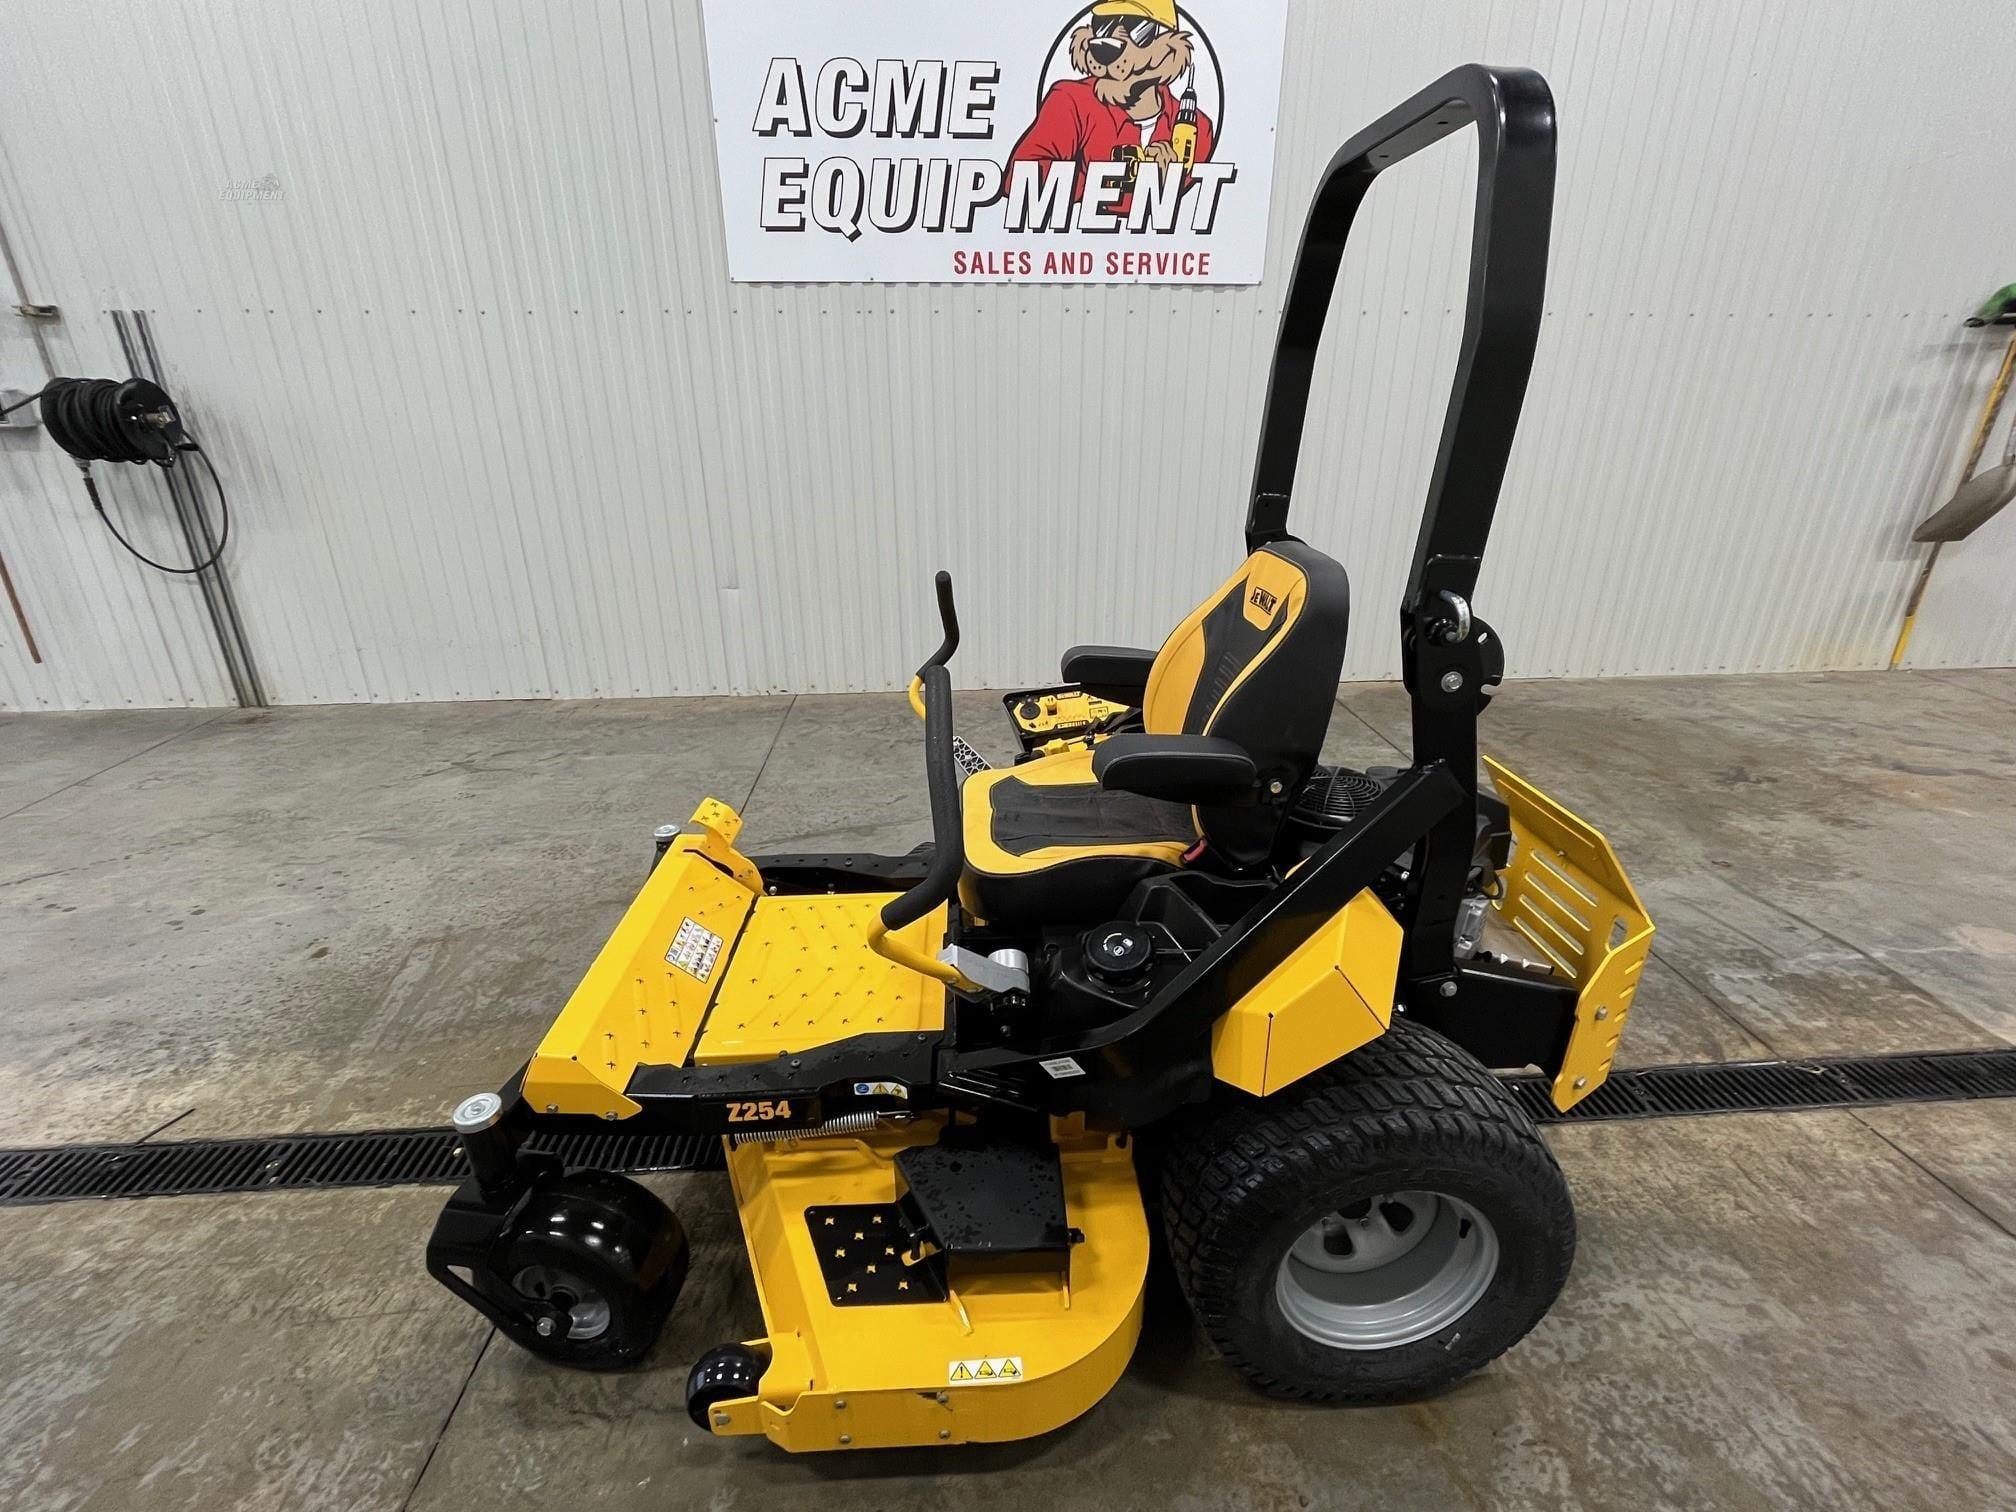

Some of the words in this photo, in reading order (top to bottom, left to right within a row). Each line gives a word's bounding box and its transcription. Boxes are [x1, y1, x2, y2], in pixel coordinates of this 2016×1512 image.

[753, 57, 1000, 139] ACME
[760, 156, 1237, 242] EQUIPMENT
[953, 251, 1032, 276] SALES
[1044, 252, 1094, 276] AND
[1105, 252, 1210, 276] SERVICE
[726, 1100, 792, 1122] Z254
